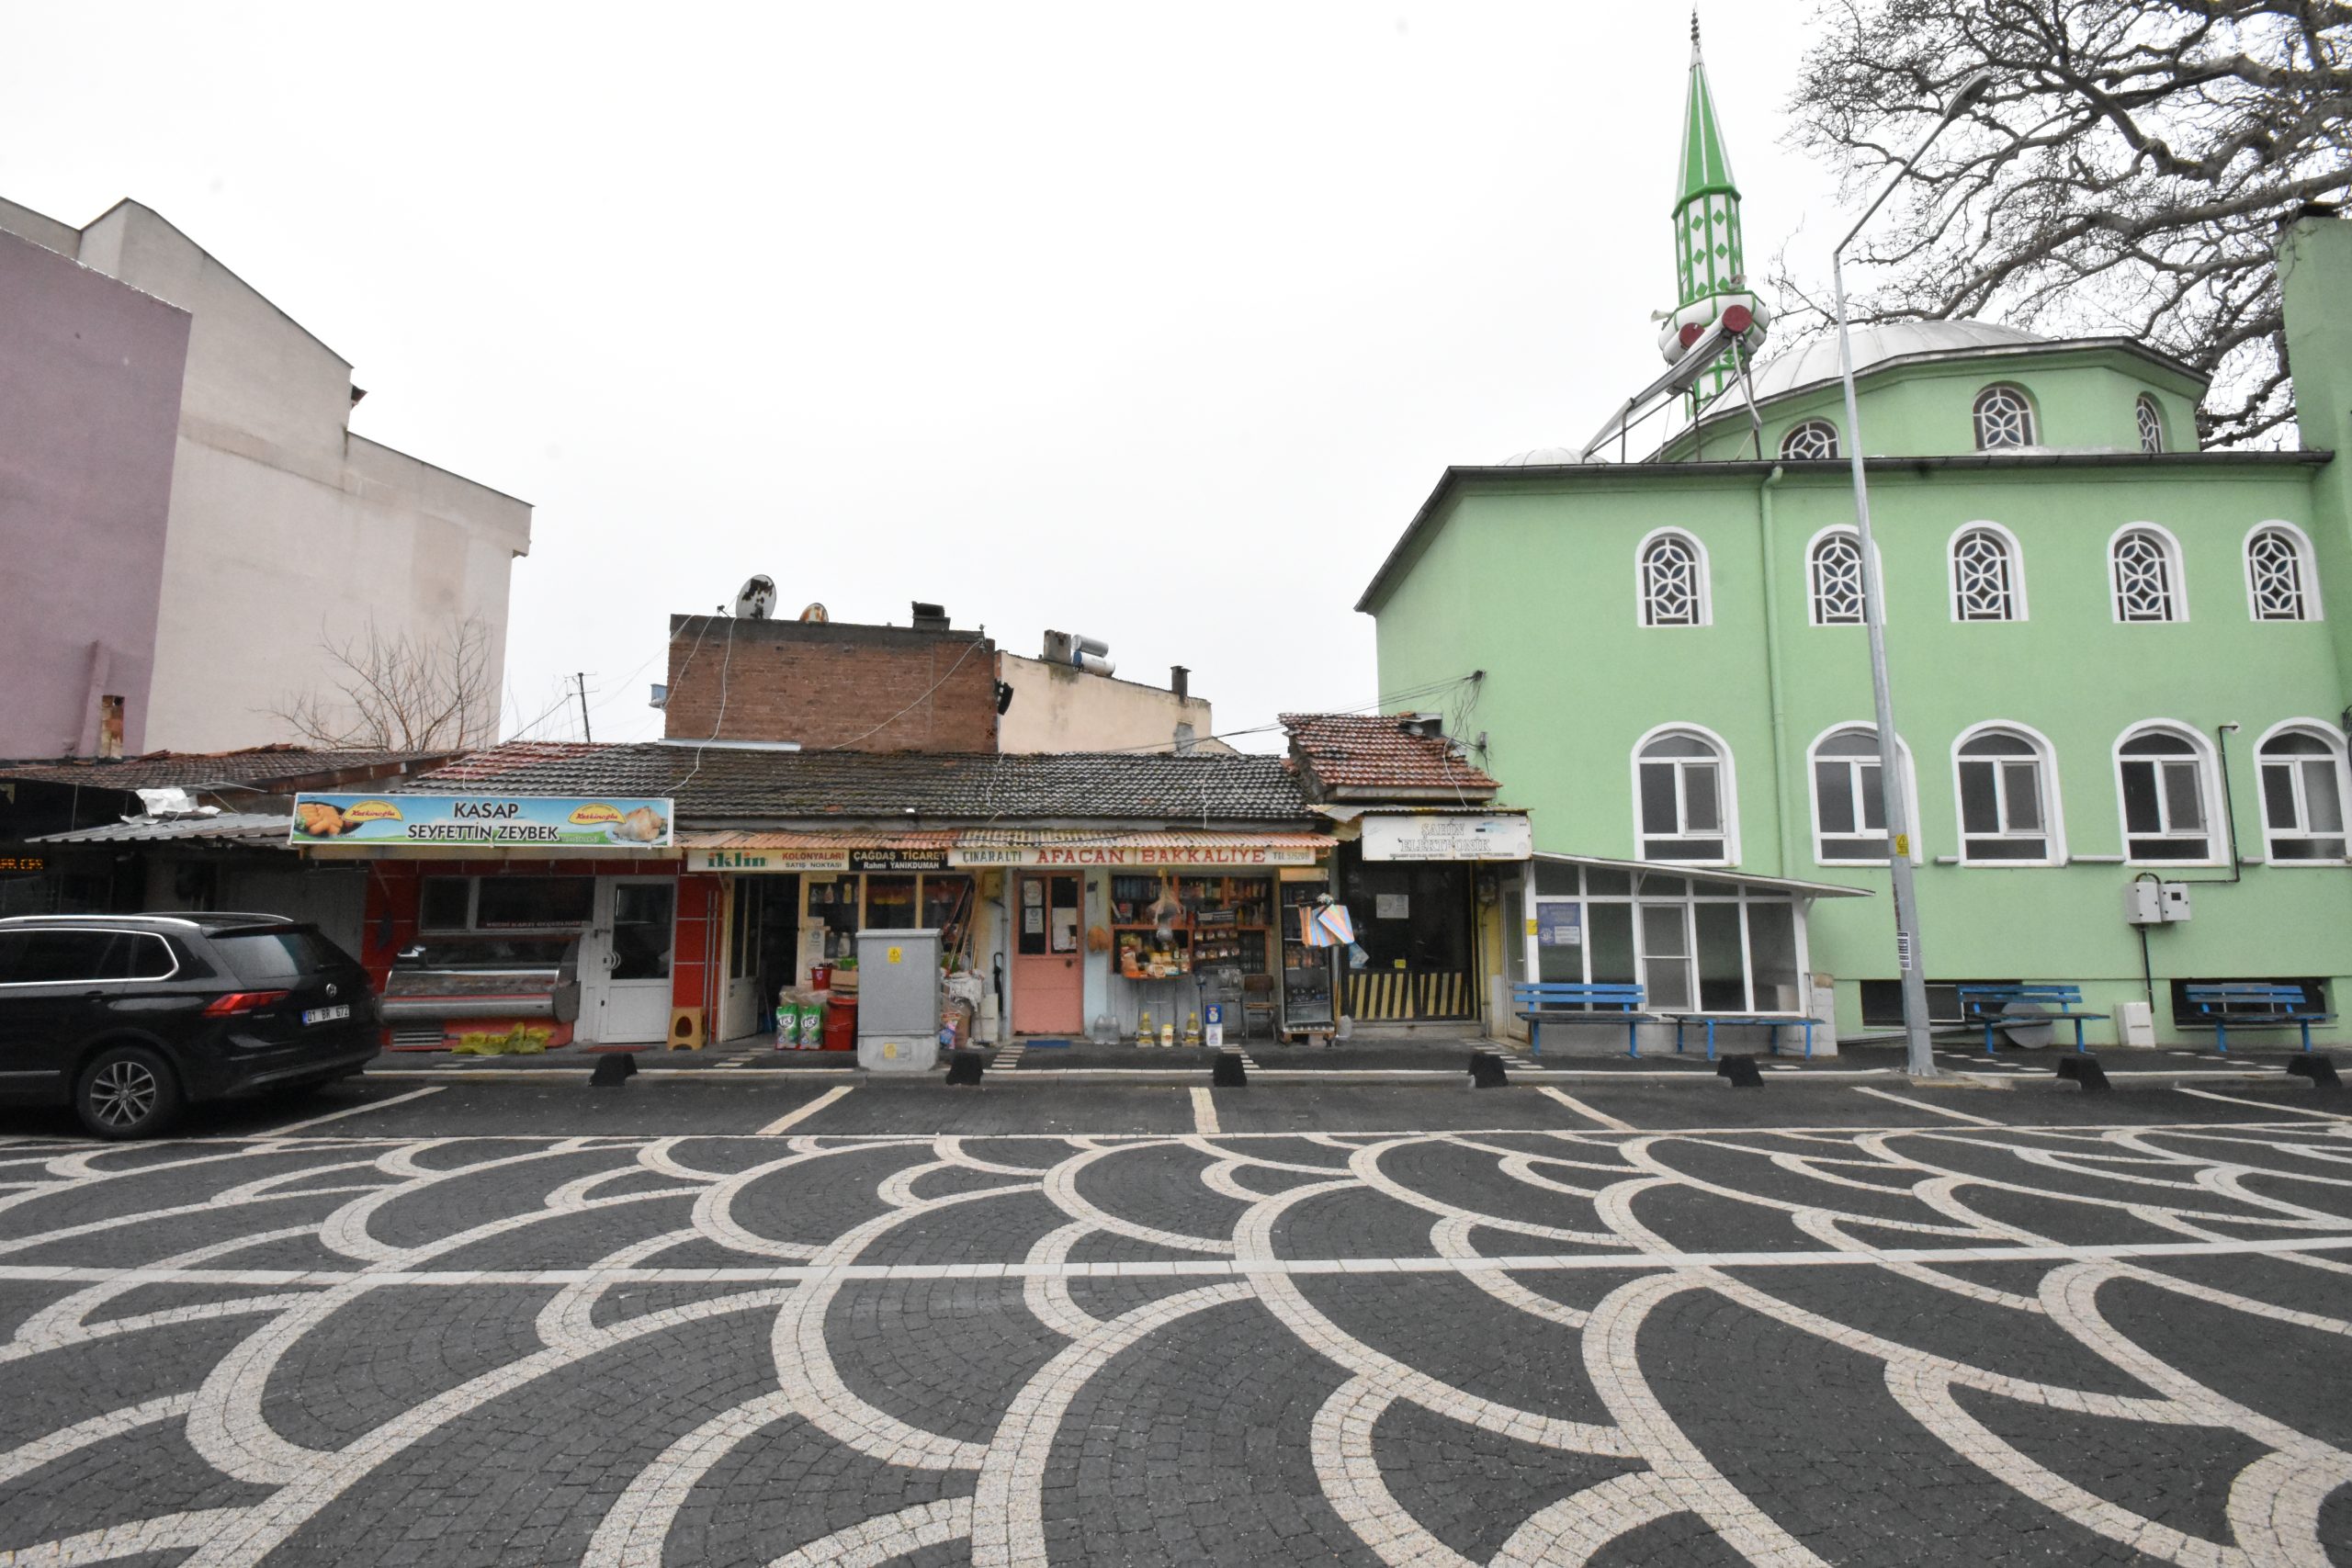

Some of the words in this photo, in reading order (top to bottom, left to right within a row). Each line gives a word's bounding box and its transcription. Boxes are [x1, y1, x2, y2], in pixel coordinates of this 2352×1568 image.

[454, 802, 519, 818] KASAP
[408, 821, 492, 839] SEYFETTİN
[497, 826, 560, 840] ZEYBEK
[1400, 837, 1492, 852] ELEKTRONİK
[707, 852, 766, 867] iklin
[782, 852, 844, 861] KOLONYALARI
[853, 850, 896, 862] ÇAĞDAŞ
[902, 849, 946, 861] TİCARET
[963, 851, 1022, 863] ÇINARALTI
[1036, 850, 1125, 863] AFACAN
